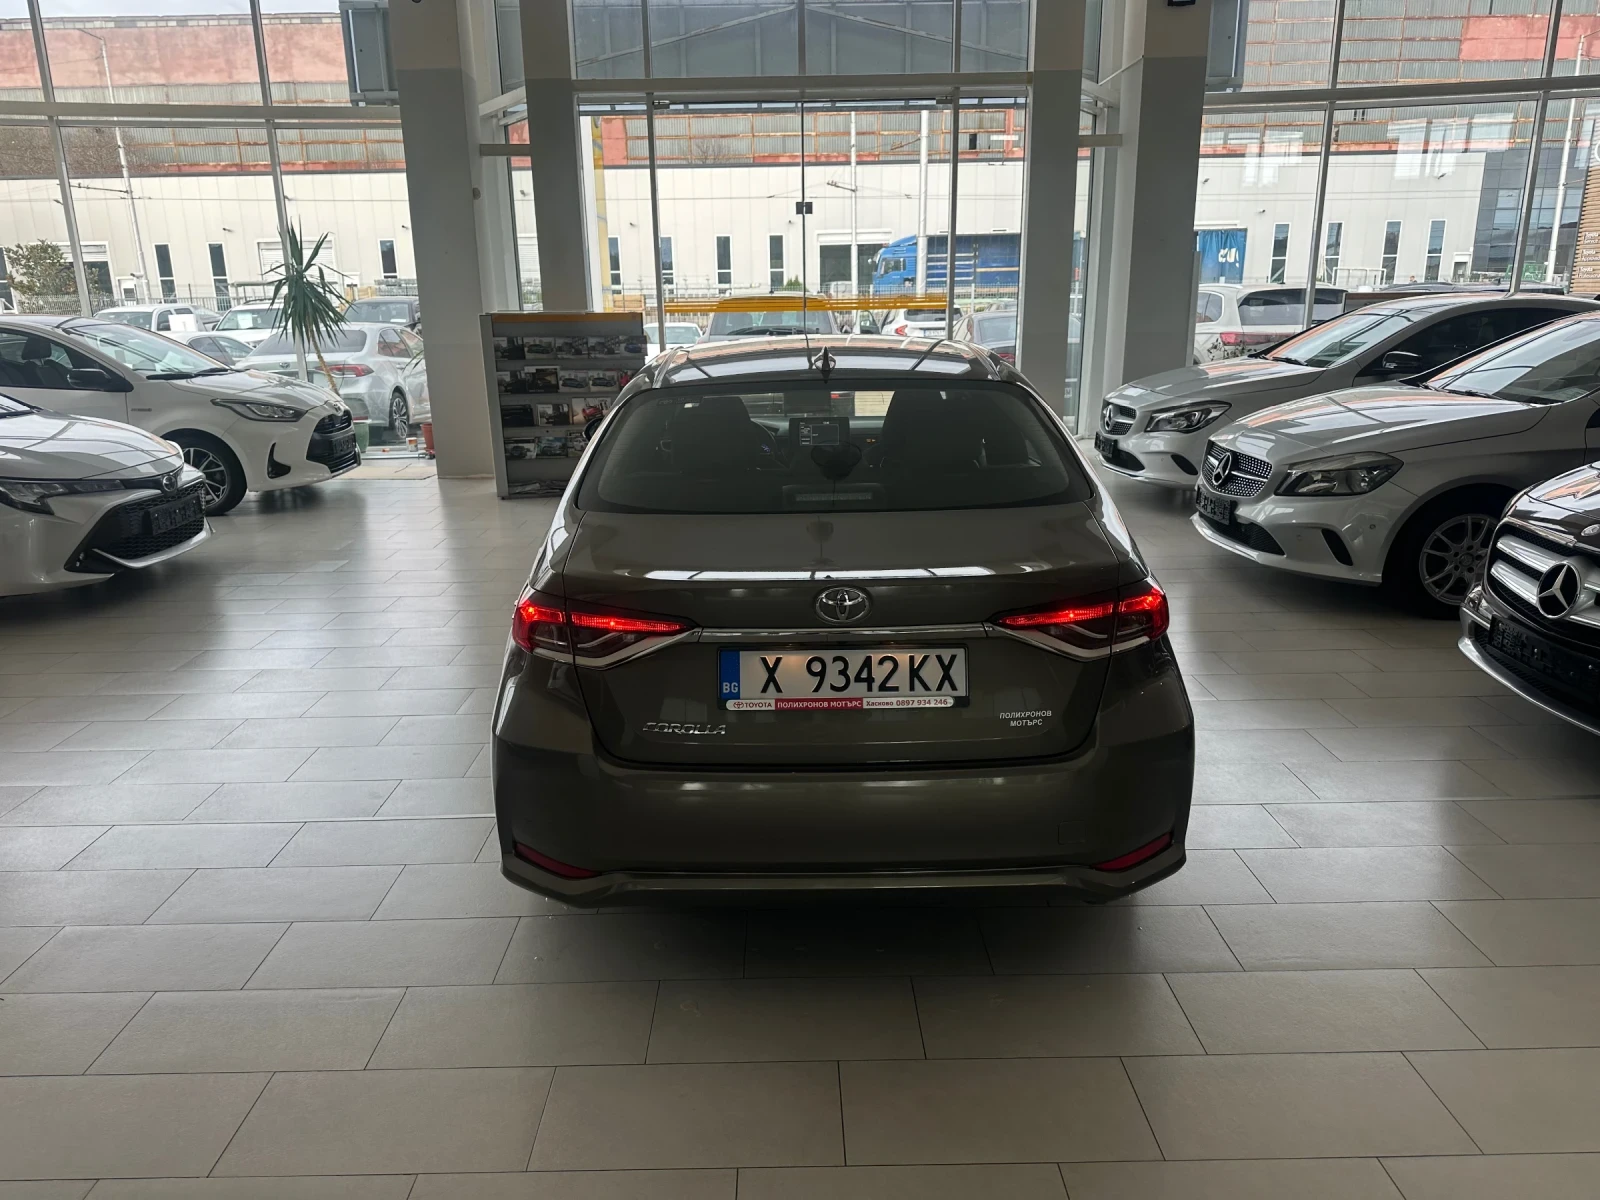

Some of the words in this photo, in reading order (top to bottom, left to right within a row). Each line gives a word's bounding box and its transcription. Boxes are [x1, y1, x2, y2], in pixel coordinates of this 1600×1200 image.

[722, 682, 739, 693] BG
[744, 701, 773, 709] TOYOTA
[777, 701, 829, 709] ПОЛИХРОНОВ
[830, 700, 862, 708] МОТЪРС
[896, 699, 915, 707] 0897
[933, 698, 948, 706] 246
[1000, 710, 1052, 719] ПОЛИХРОНОВ
[1010, 719, 1043, 727] МОТЪРС
[642, 722, 726, 735] COROLLA
